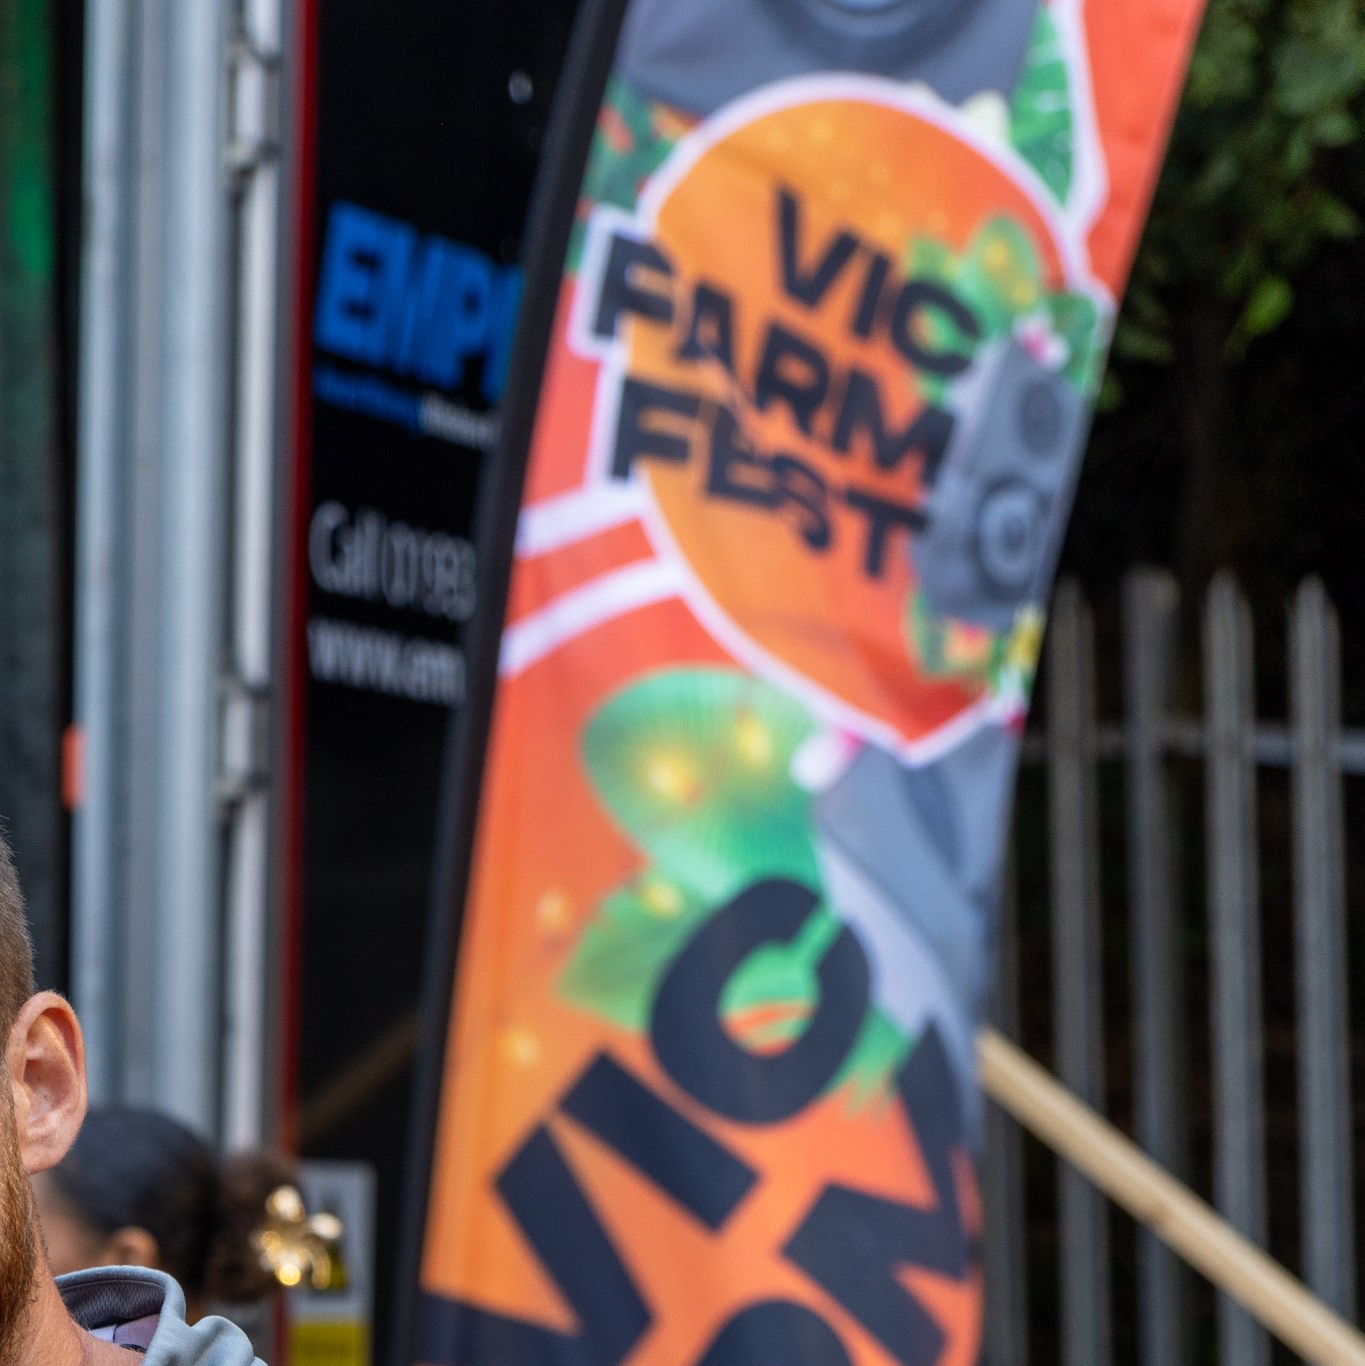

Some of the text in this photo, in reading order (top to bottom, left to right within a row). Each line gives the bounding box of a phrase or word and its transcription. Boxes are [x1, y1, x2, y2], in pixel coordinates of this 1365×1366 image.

[590, 231, 959, 490] FARM
[775, 184, 983, 377] VIC
[609, 379, 929, 581] FEST
